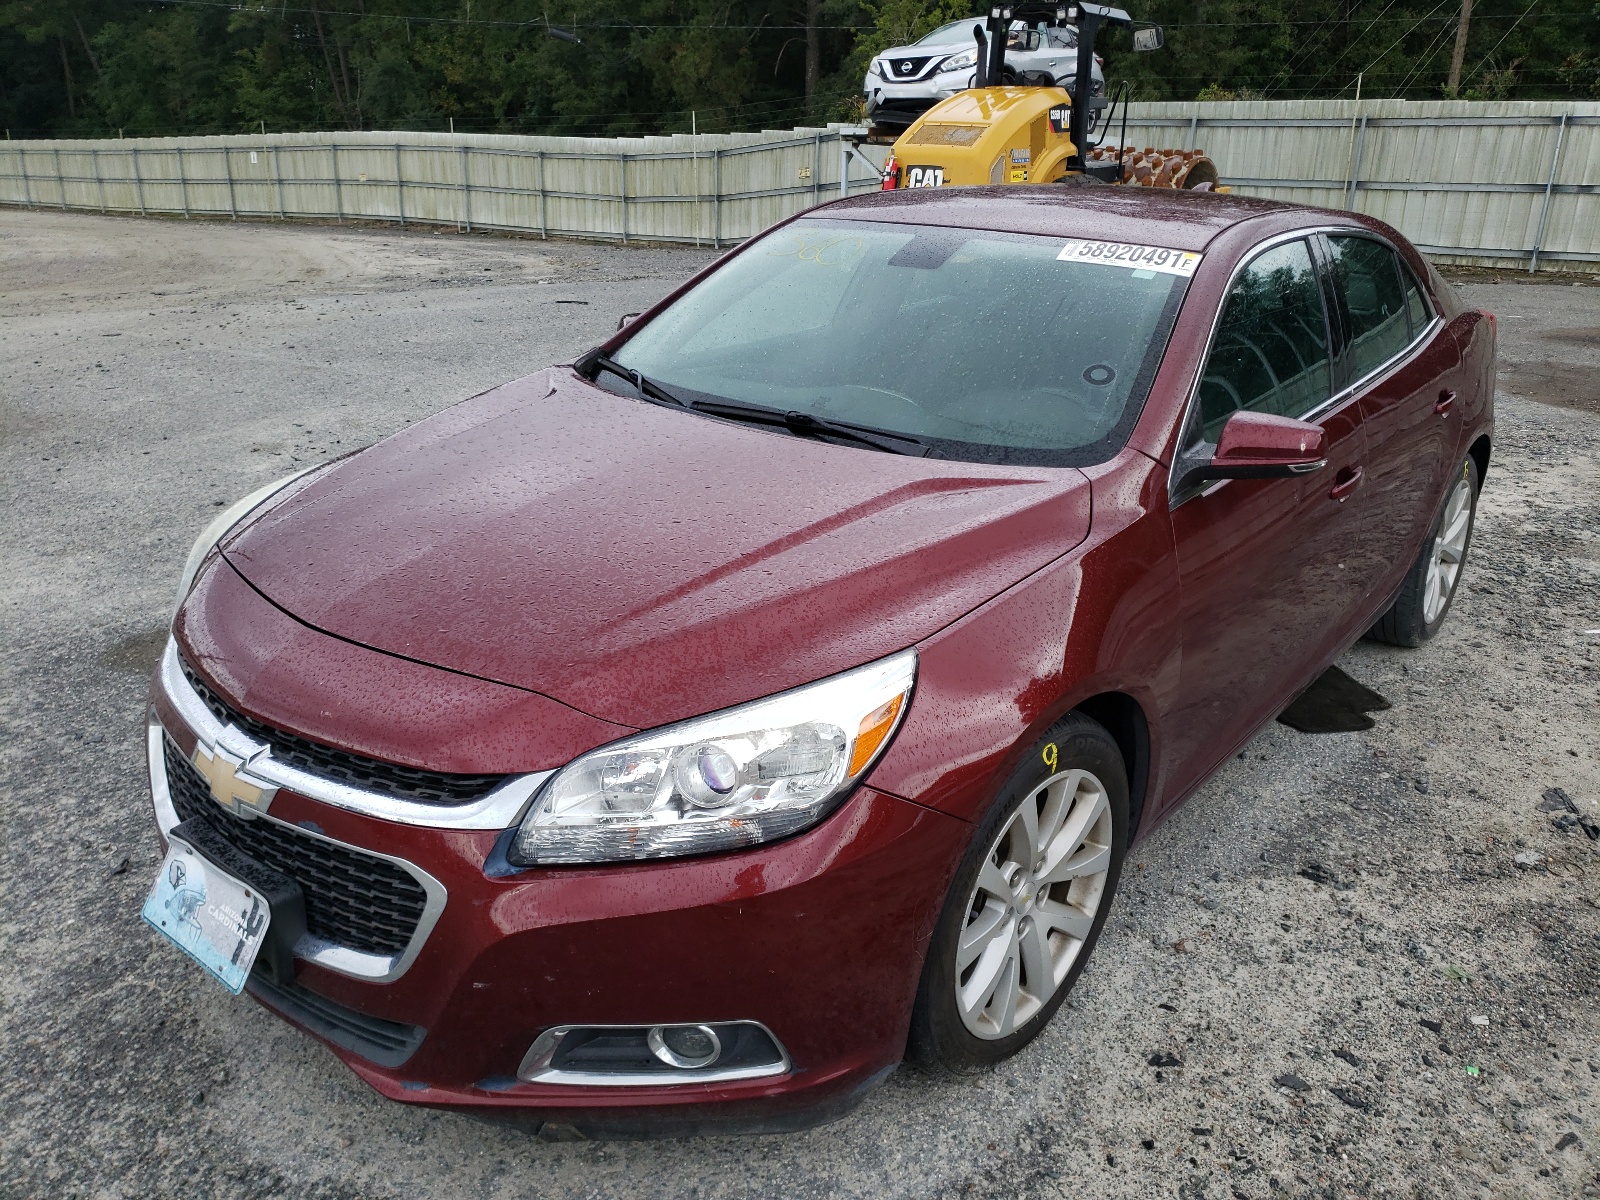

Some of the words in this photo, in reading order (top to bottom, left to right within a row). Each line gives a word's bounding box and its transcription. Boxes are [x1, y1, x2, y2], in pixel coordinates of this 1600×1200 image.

[908, 167, 944, 189] CAT
[1078, 242, 1184, 268] 58920491
[1042, 742, 1058, 775] 9
[207, 904, 255, 946] CARDINALS
[219, 903, 248, 929] ARIZONA
